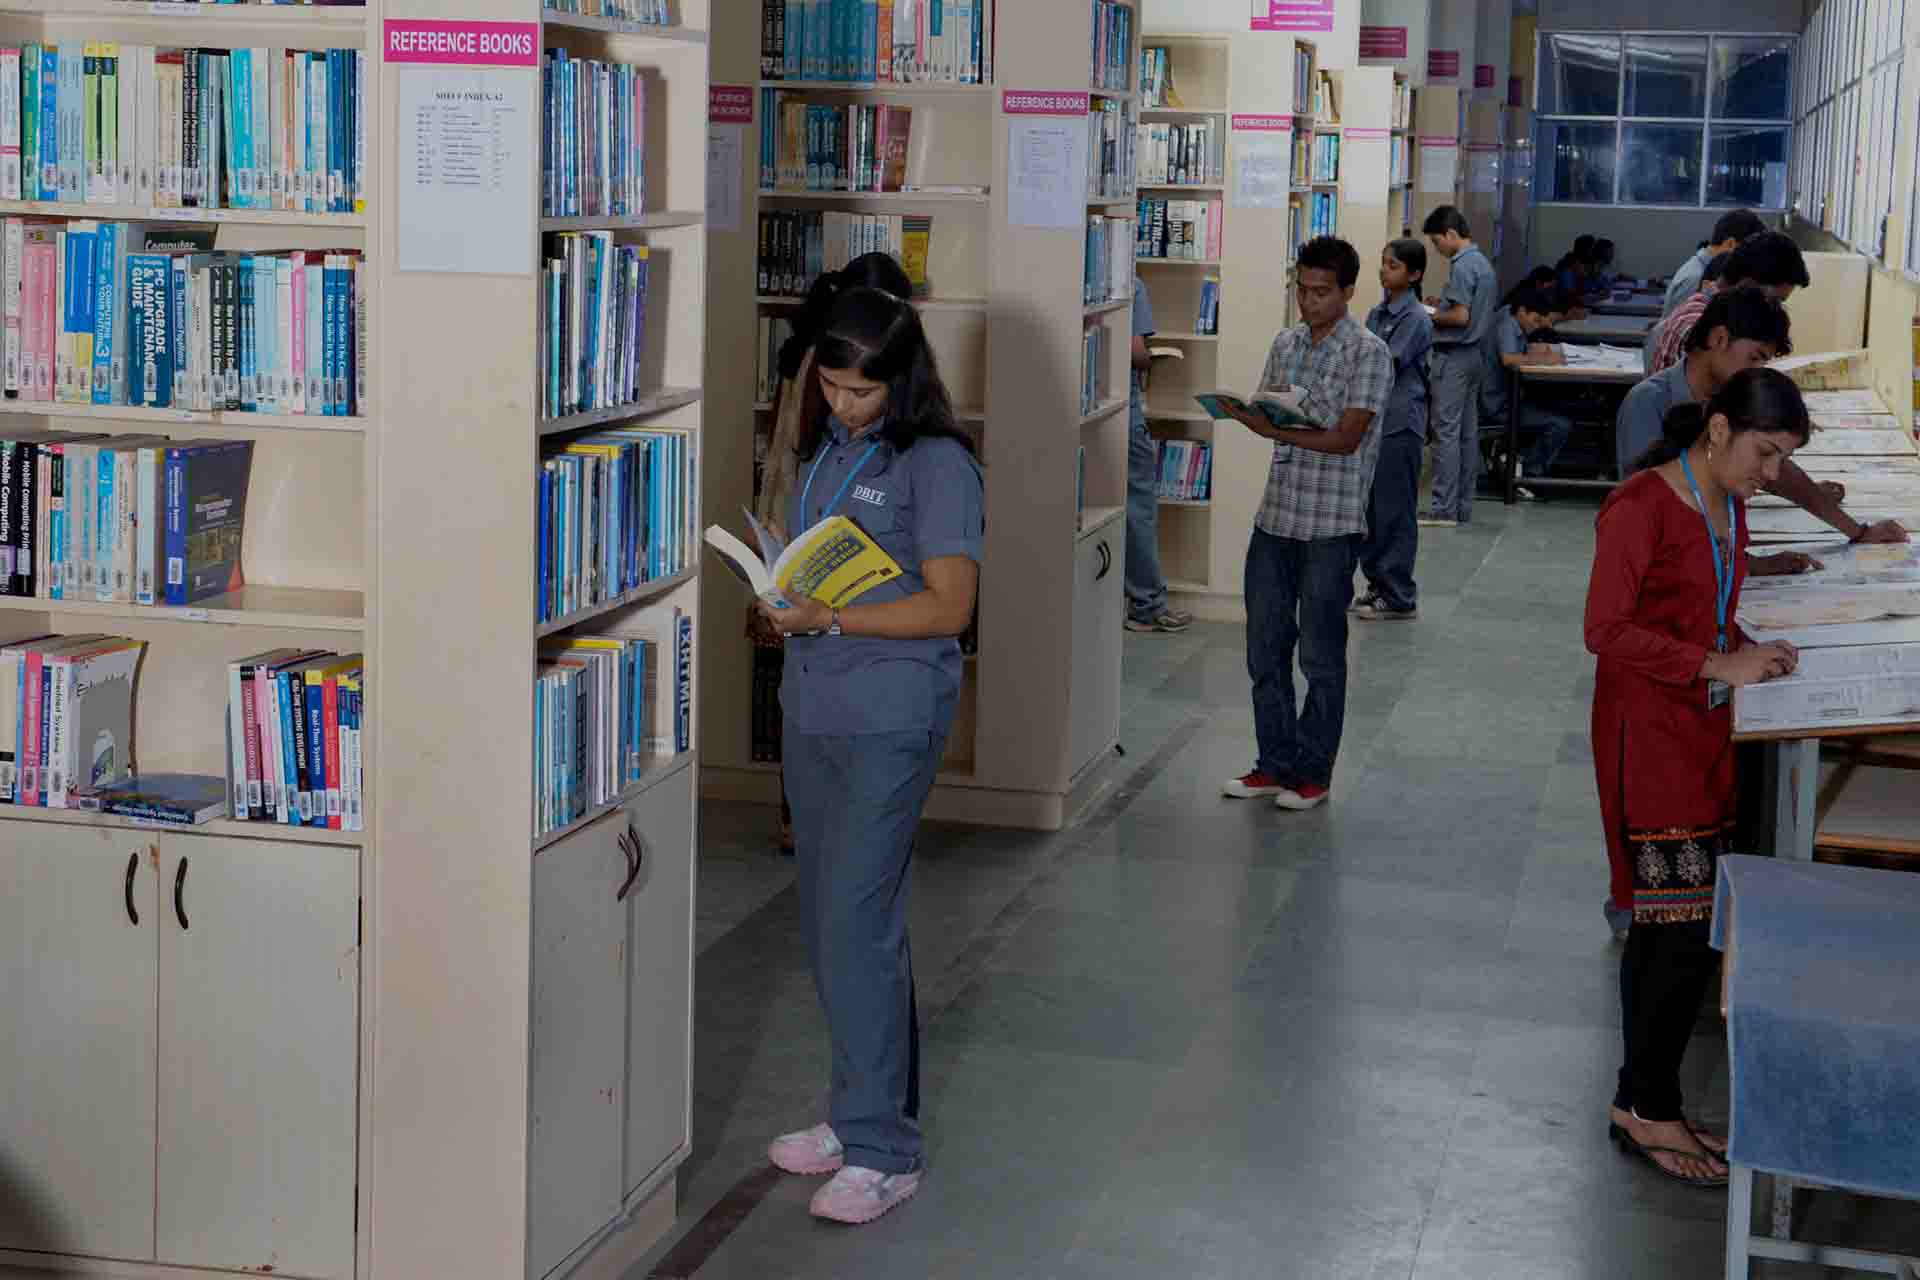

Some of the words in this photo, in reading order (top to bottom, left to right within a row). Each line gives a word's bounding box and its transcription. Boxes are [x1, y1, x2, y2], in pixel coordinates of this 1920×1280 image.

[390, 31, 477, 54] REFERENCE
[480, 32, 533, 55] BOOKS
[1006, 96, 1054, 109] REFERENCE
[1056, 97, 1086, 110] BOOKS
[144, 267, 154, 278] &
[155, 267, 165, 287] PC
[97, 286, 105, 311] YOUR
[132, 267, 143, 309] GUIDE
[176, 289, 185, 302] The
[226, 304, 234, 318] How
[326, 294, 335, 312] How
[337, 294, 345, 312] How
[144, 282, 155, 368] MAINTENANC
[155, 290, 166, 354] UPGRADE
[337, 313, 345, 322] to
[0, 450, 10, 485] Mobile
[21, 461, 30, 488] Mobile
[854, 484, 886, 503] DBIT
[0, 486, 10, 542] Computing
[19, 489, 30, 531] Computing
[20, 532, 30, 550] Prin
[54, 666, 63, 712] Embedded
[294, 708, 303, 732] SYSTEMS
[311, 709, 321, 745] Real-Time
[295, 732, 306, 769] DEVELOPMENT
[312, 745, 322, 776] Systems
